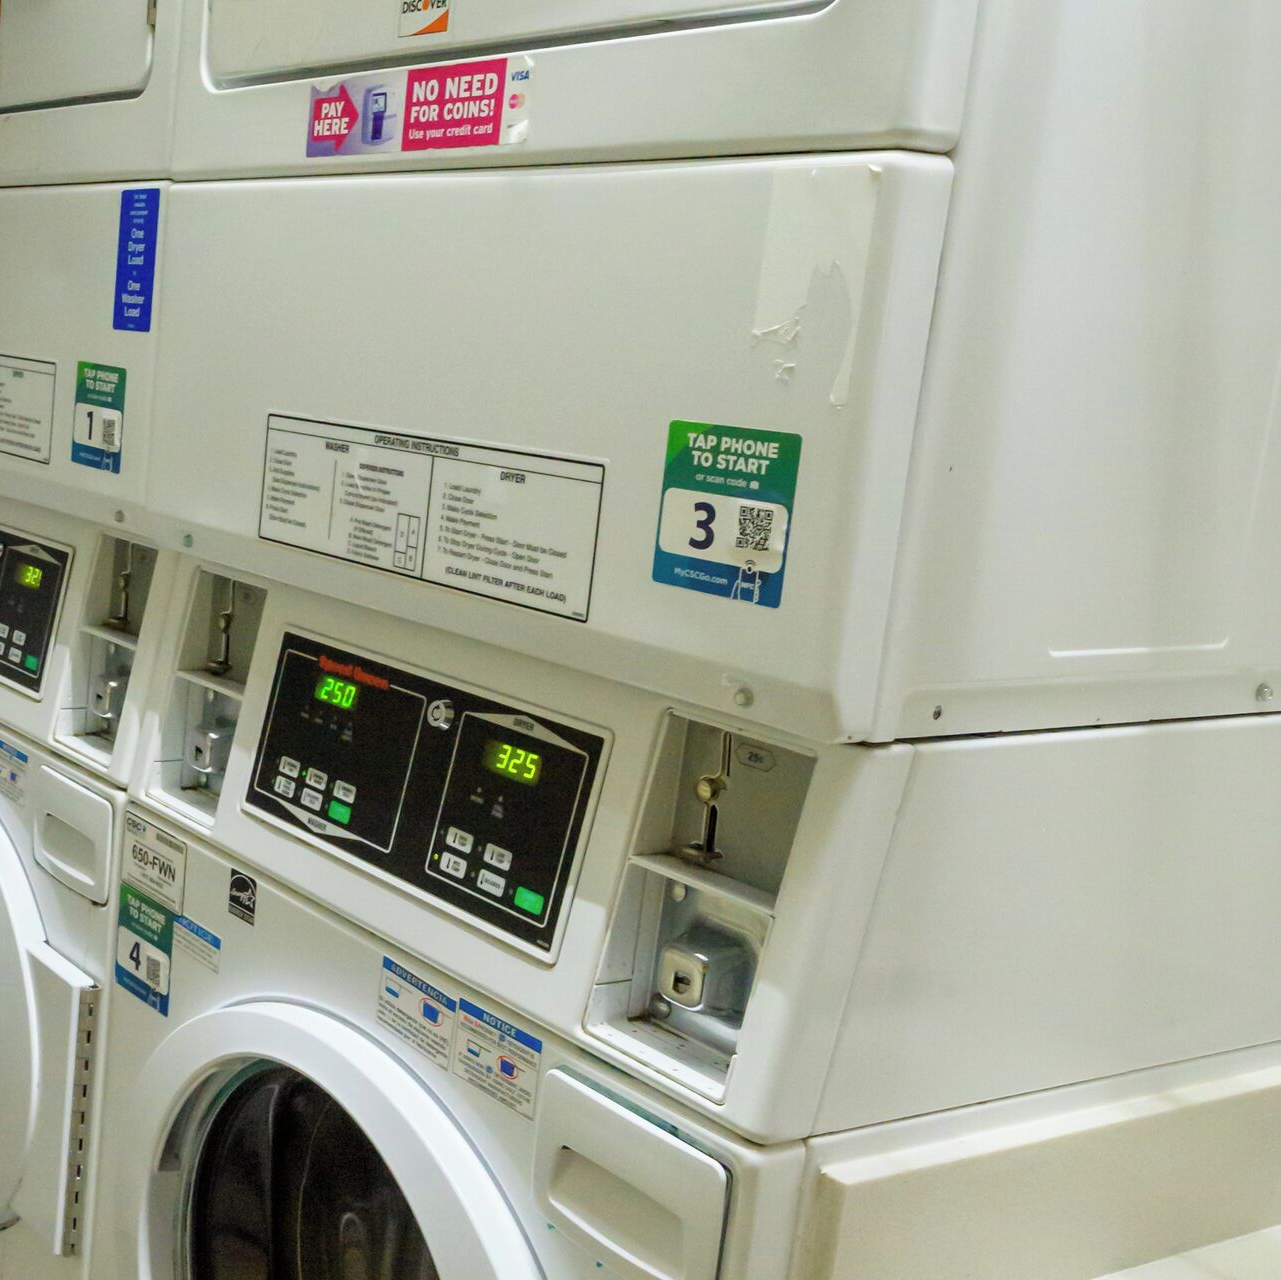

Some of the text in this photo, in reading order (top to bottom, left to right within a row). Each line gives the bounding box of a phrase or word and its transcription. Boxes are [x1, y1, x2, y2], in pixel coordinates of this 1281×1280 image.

[412, 72, 499, 102] NO NEED
[511, 70, 530, 82] VISA
[321, 100, 345, 118] PAY
[410, 98, 494, 123] FOR COINS!
[313, 117, 350, 136] HERE
[408, 122, 493, 141] Use your credit card
[87, 411, 94, 440] 1
[324, 440, 350, 454] WASHER
[373, 433, 460, 457] OPERATING INSTRUCTIONS
[687, 433, 780, 459] TAP PHONE
[692, 451, 770, 475] TO START
[499, 470, 526, 484] DRYER
[706, 475, 725, 485] scan
[726, 477, 747, 488] code
[688, 501, 716, 550] 3
[444, 565, 567, 604] (CLEAN LINT FILTER AFTER EACH LOAD)
[674, 567, 728, 585] MyCSCGo.com
[320, 678, 356, 708] 250
[513, 718, 535, 732] DRYER
[496, 744, 539, 779] 325
[127, 817, 142, 833] CSC
[132, 844, 176, 883] 650-FWN
[129, 941, 141, 972] 4
[390, 964, 447, 1005] ADVERTENCIA
[483, 1012, 518, 1037] NOTICE
